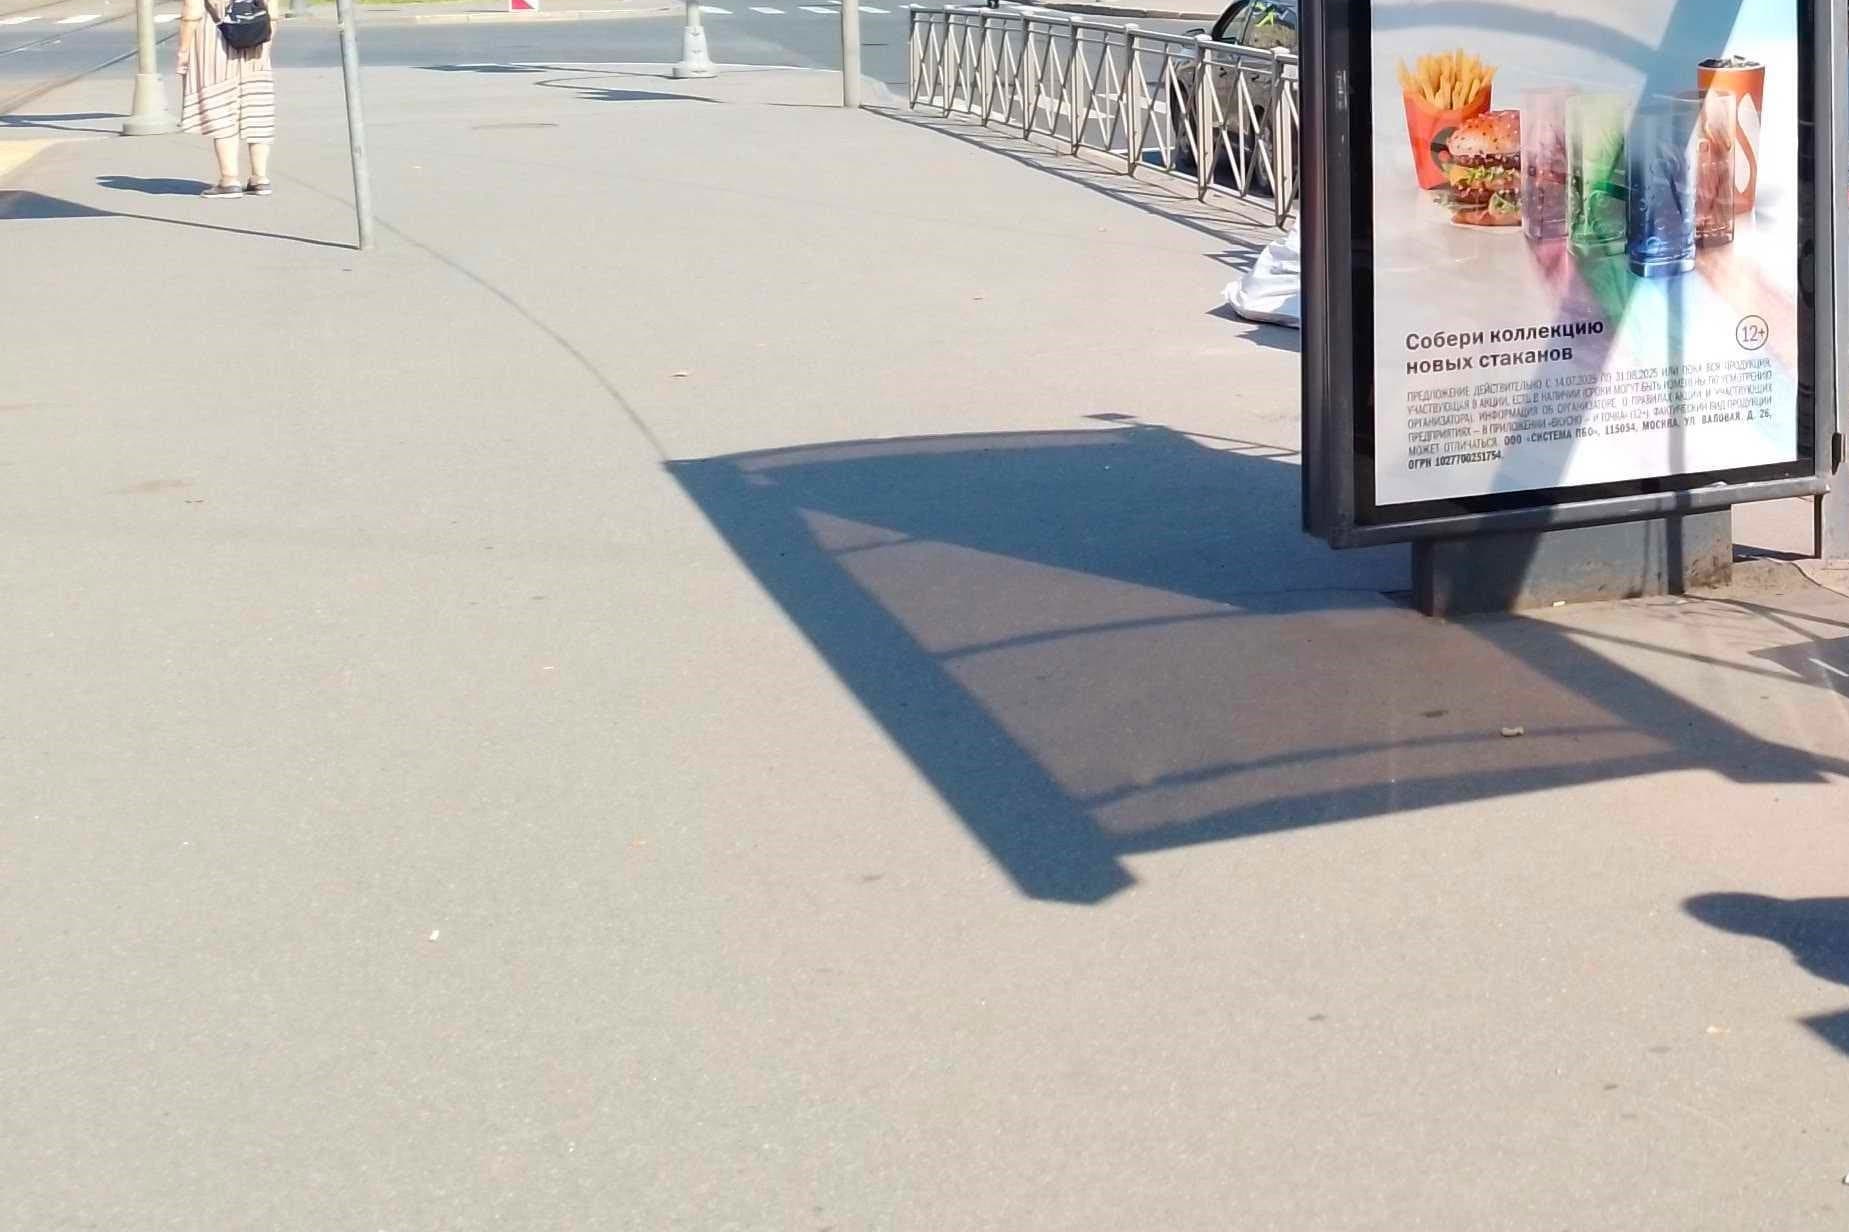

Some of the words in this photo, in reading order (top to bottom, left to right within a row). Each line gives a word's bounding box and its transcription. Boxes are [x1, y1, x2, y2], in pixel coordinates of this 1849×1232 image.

[1406, 331, 1484, 350] Собери
[1490, 321, 1604, 344] коллекцию
[1741, 325, 1765, 343] 12+
[1406, 356, 1473, 375] новых
[1478, 347, 1574, 369] стаканов
[1473, 377, 1541, 396] ДЕЙСТВИТЕЛЬНО
[1408, 442, 1439, 455] МОЖЕТ
[1504, 434, 1521, 445] ООО
[1408, 457, 1431, 469] ОГРН
